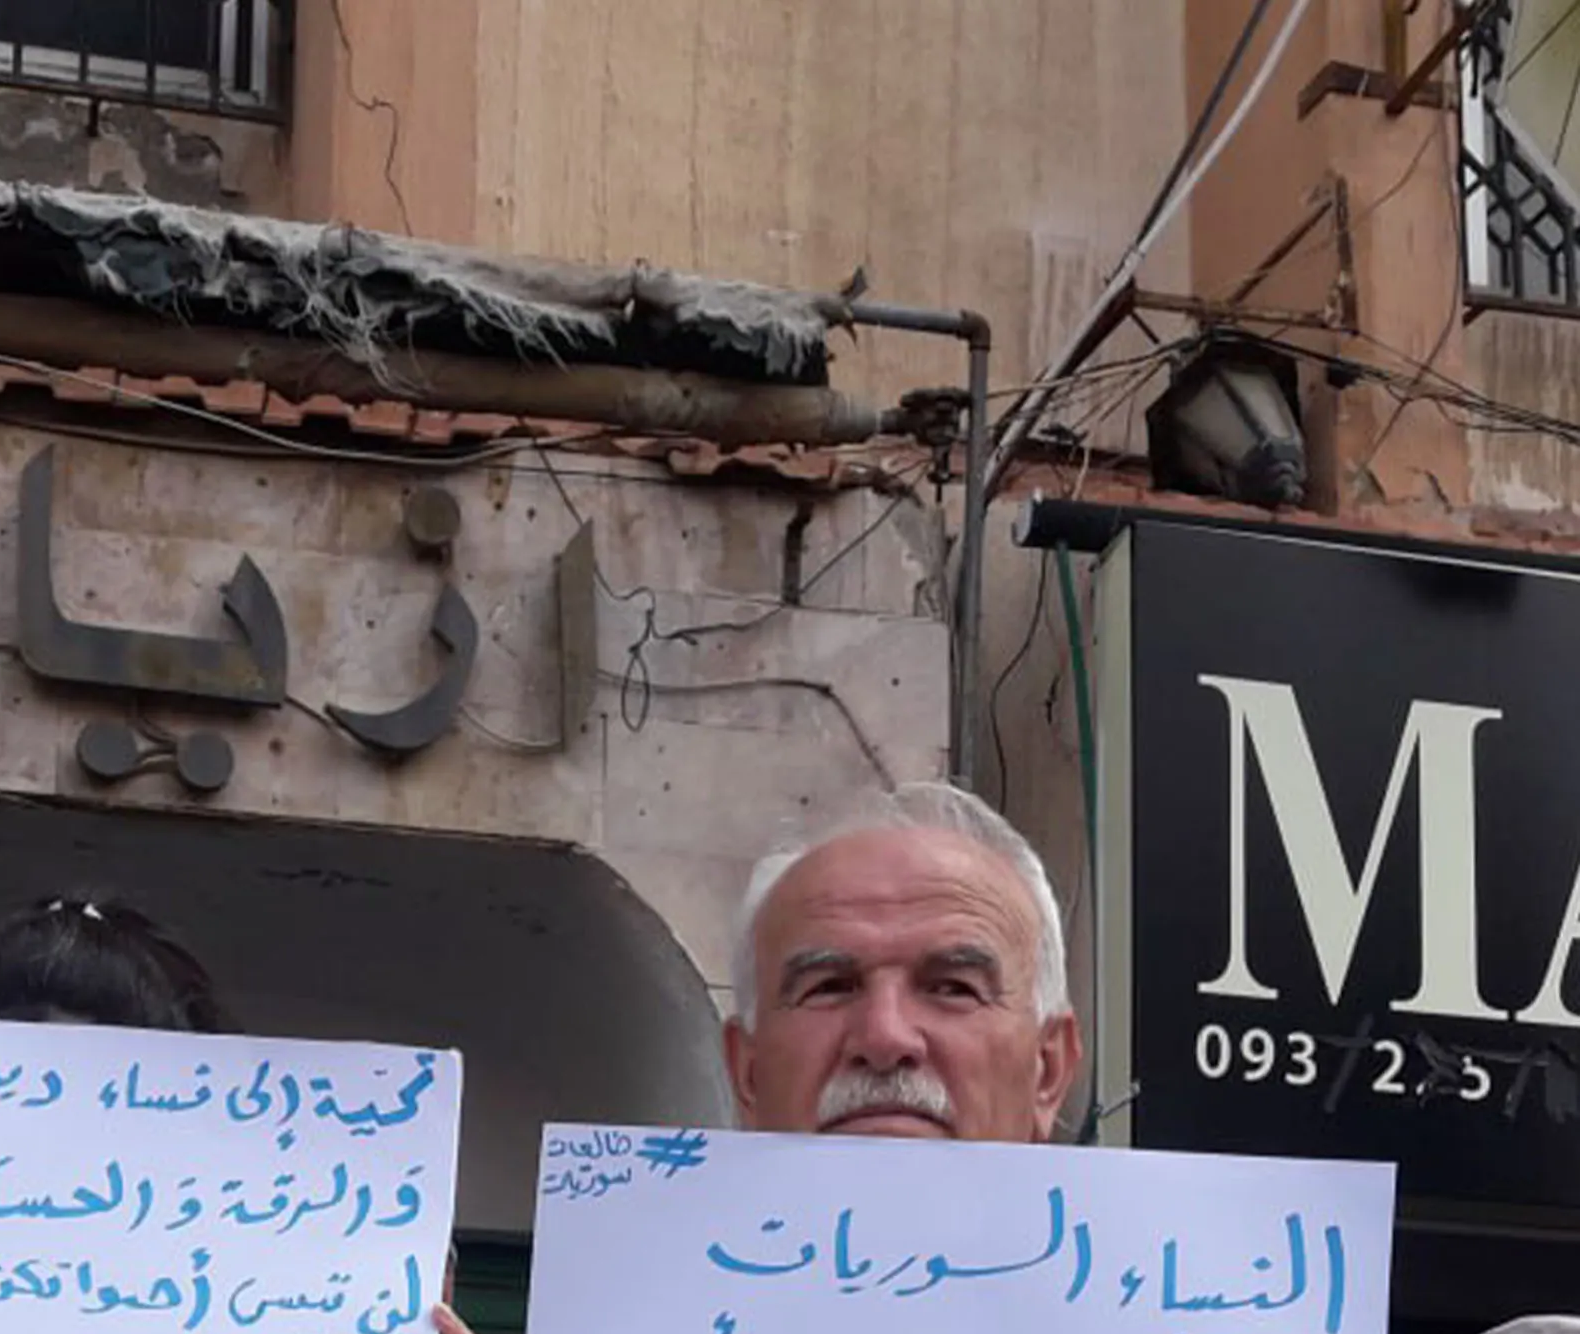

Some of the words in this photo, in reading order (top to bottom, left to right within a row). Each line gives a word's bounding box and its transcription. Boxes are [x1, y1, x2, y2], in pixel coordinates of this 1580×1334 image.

[1197, 673, 1580, 1027] M
[99, 1062, 213, 1113] نساء
[225, 1060, 301, 1151] إلى
[220, 1162, 372, 1237] الرقة
[706, 1186, 1092, 1303] السوريات
